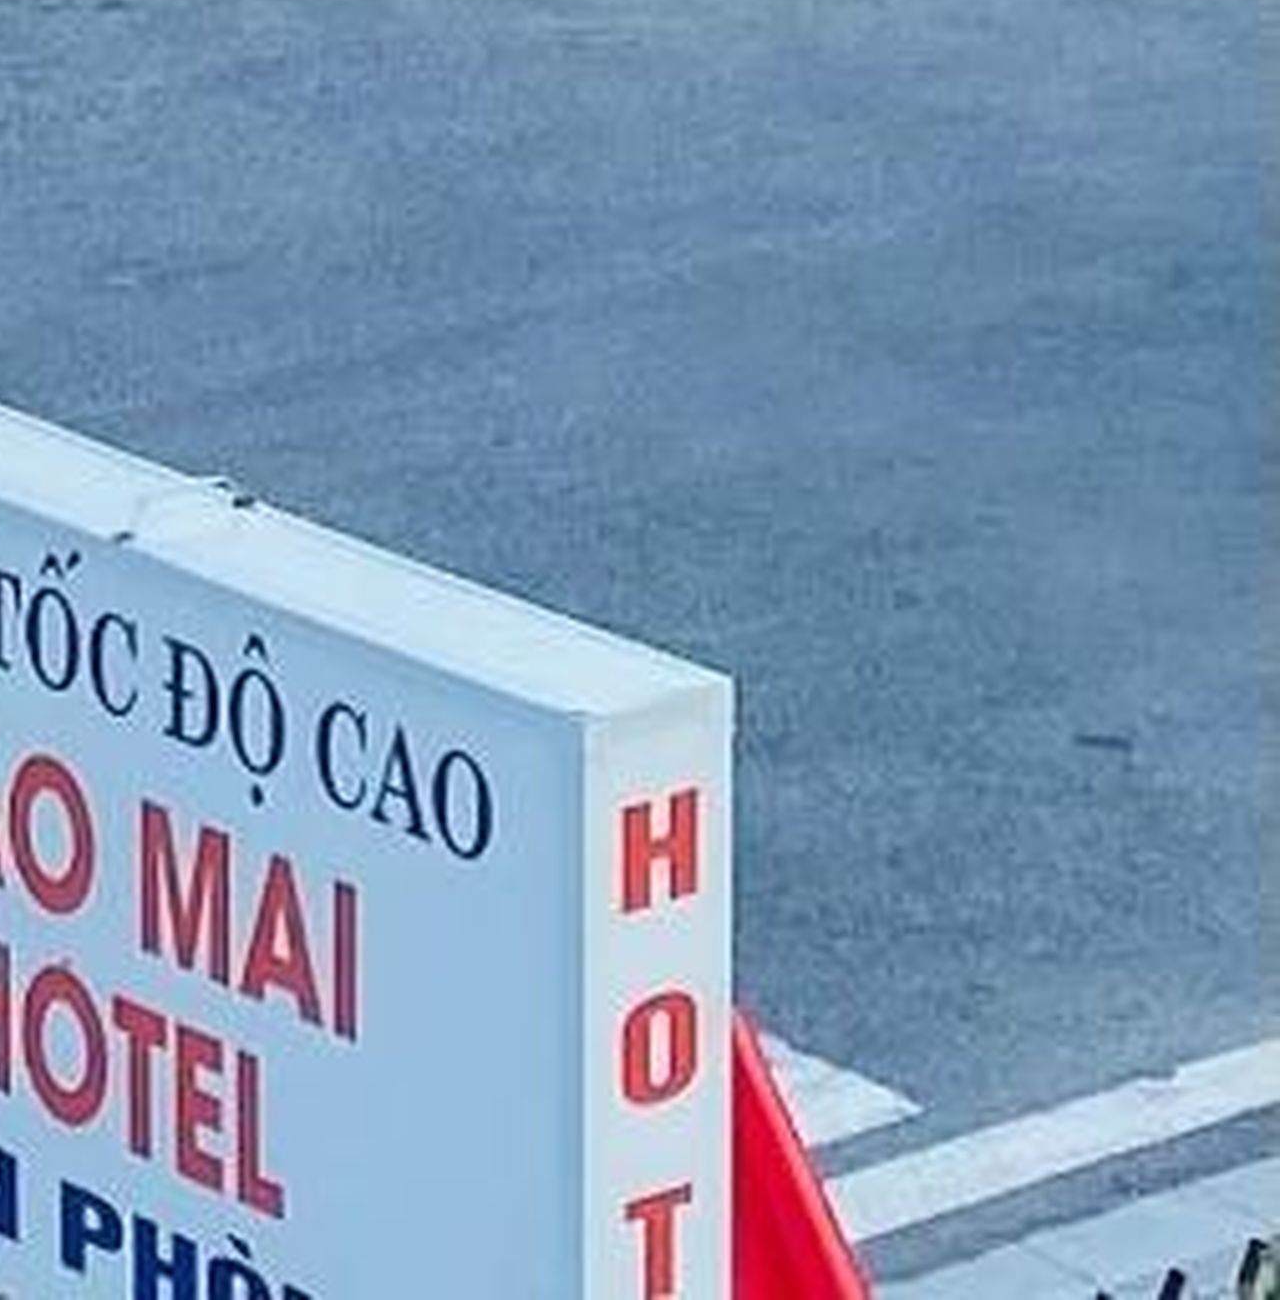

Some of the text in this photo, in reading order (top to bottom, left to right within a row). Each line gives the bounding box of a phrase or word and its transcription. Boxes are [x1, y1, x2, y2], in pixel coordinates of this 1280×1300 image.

[162, 633, 286, 808] ĐỘ
[316, 702, 494, 861] CAO
[140, 797, 358, 1043] MAI
[60, 1179, 314, 1300] PHÒ
